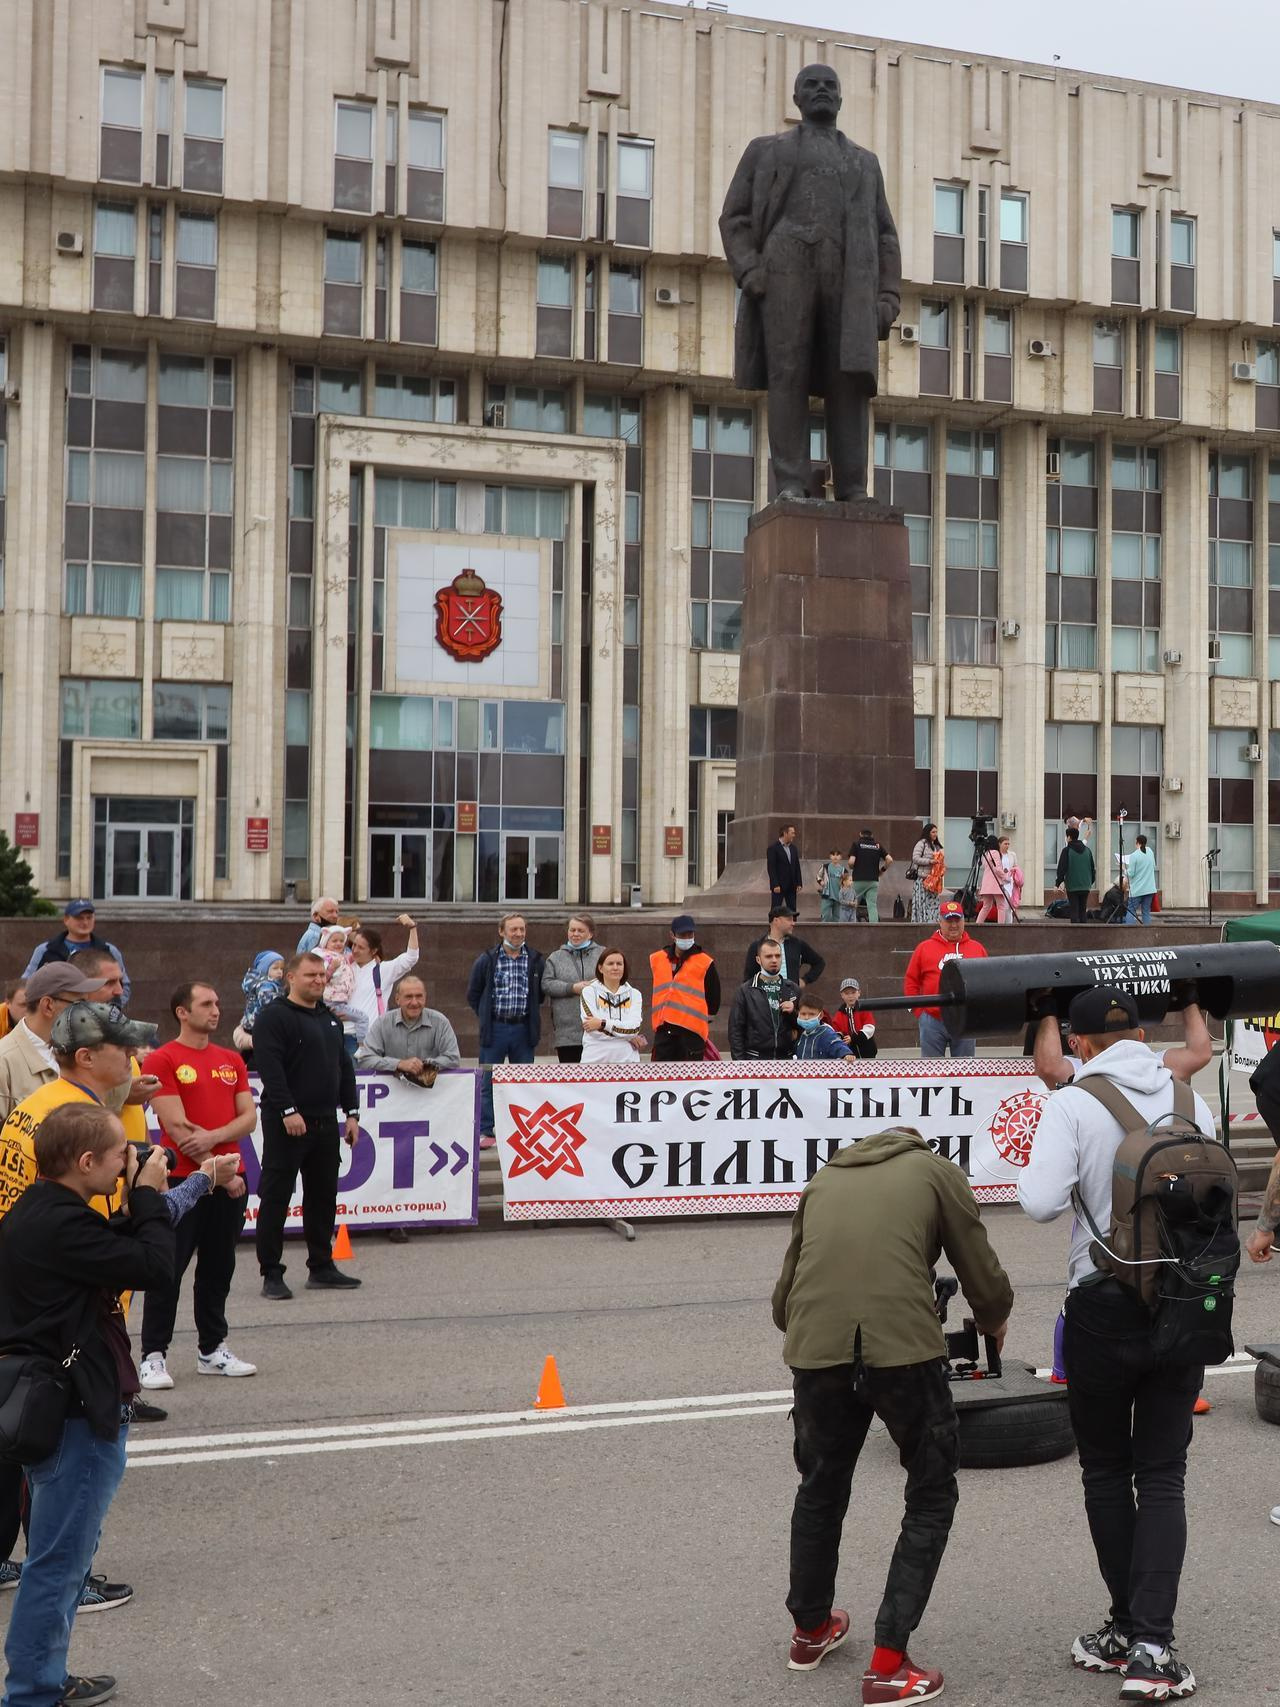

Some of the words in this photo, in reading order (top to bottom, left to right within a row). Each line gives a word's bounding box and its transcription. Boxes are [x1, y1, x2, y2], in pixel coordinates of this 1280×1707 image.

[1076, 951, 1178, 966] ФЕДЕРАЦИЯ
[1092, 962, 1168, 980] ТЯЖЁЛОЙ
[827, 1086, 974, 1118] БЫТЬ
[611, 1134, 975, 1189] СИЛЬНМ
[404, 1200, 447, 1213] торца)
